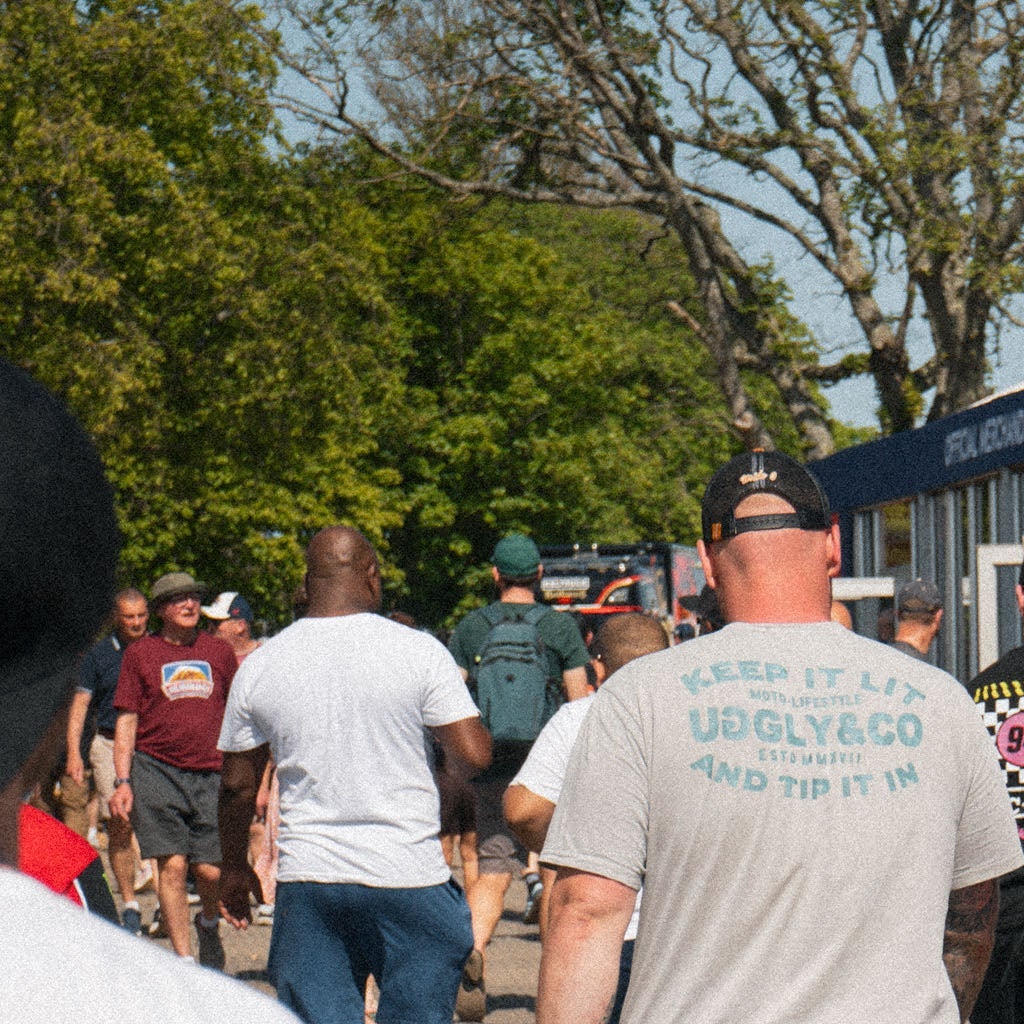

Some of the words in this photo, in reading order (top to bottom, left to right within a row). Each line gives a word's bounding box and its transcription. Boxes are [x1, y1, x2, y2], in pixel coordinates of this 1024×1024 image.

[680, 660, 788, 695] KEEP
[805, 667, 844, 689] IT
[860, 671, 926, 705] LIT
[689, 753, 769, 793] AND
[778, 774, 831, 800] TIP
[842, 773, 874, 797] IT
[884, 762, 921, 793] IN
